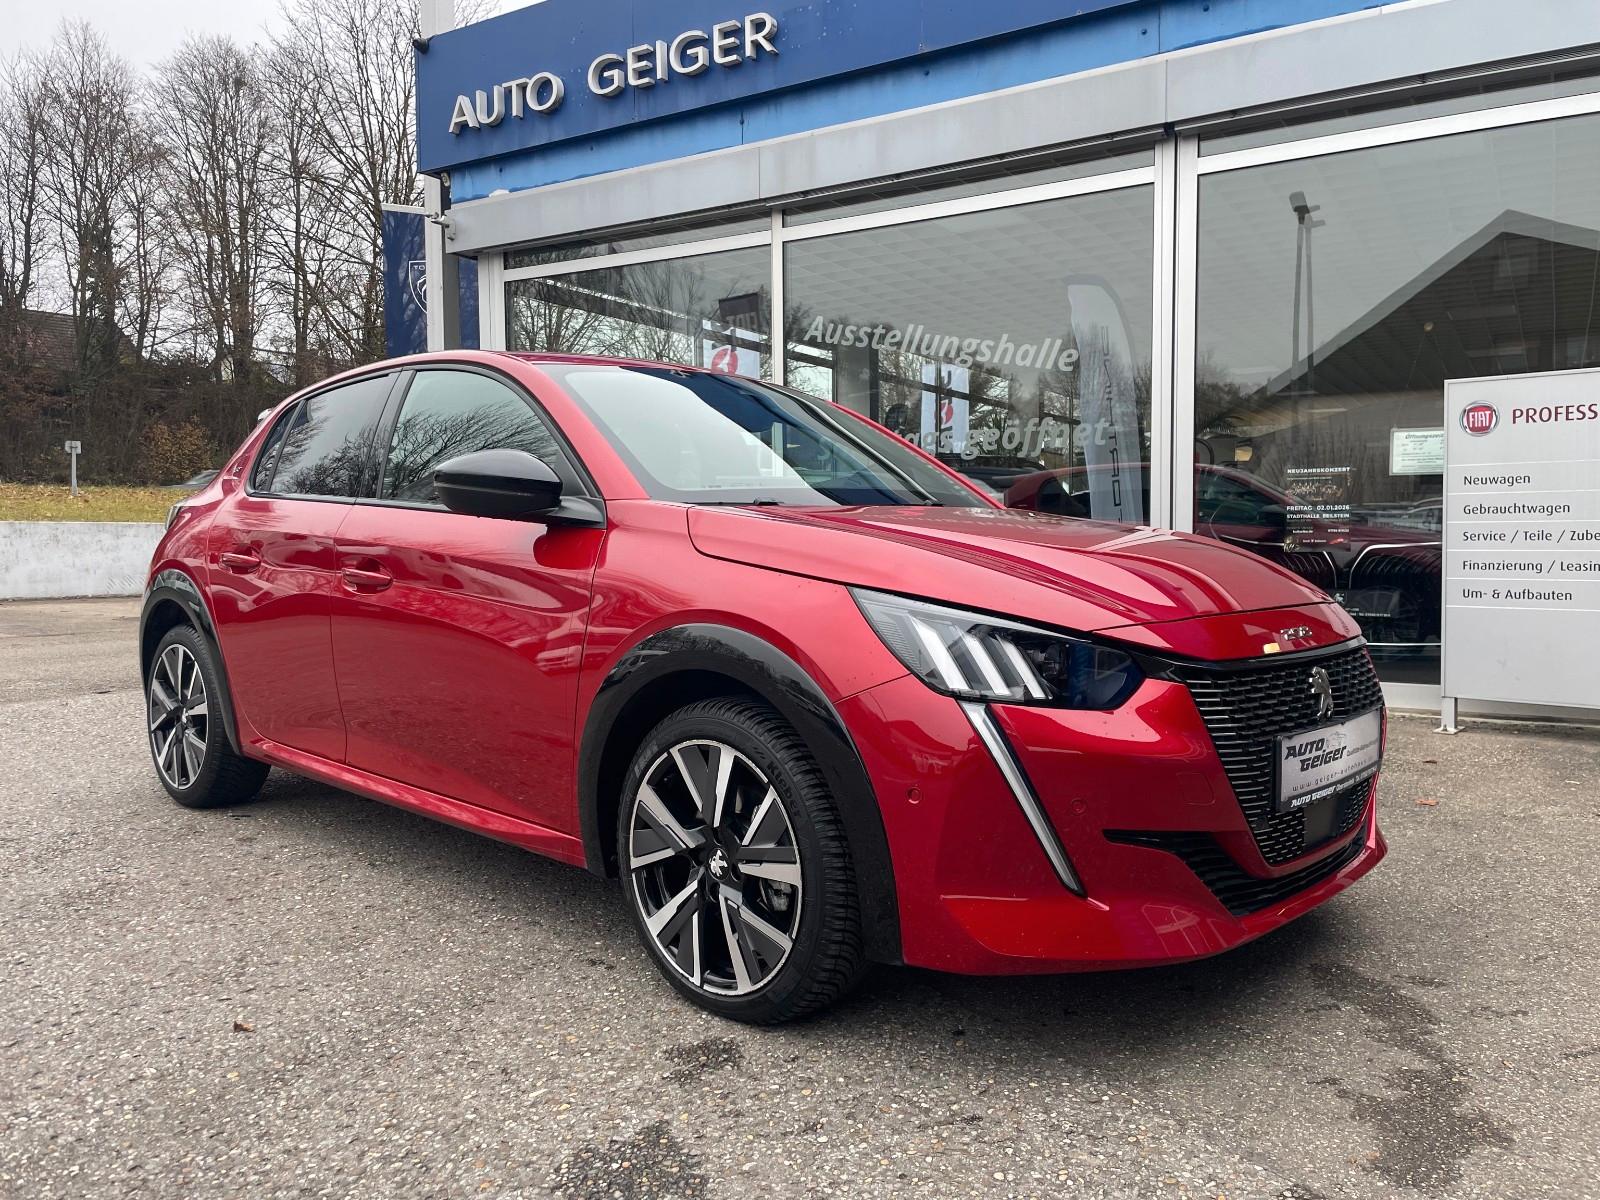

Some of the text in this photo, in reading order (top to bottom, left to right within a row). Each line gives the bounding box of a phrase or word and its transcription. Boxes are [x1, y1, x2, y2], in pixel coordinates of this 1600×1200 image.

[448, 12, 780, 136] AUTO GEIGER
[803, 315, 1079, 372] Ausstellungshalle
[1468, 410, 1492, 428] FIAT
[1512, 403, 1600, 424] PROFESS
[960, 416, 1110, 461] geöffnet
[1463, 475, 1531, 486] Neuwagen
[1463, 503, 1571, 516] Gebrauchtwagen
[1463, 531, 1506, 541] Service
[1523, 531, 1552, 541] Teile
[1462, 560, 1543, 573] Finanzierung
[1560, 561, 1600, 572] Leasin
[1462, 589, 1572, 600] Um- & Aufbauten
[1284, 738, 1325, 760] AUTO
[1290, 794, 1312, 808] AUTO
